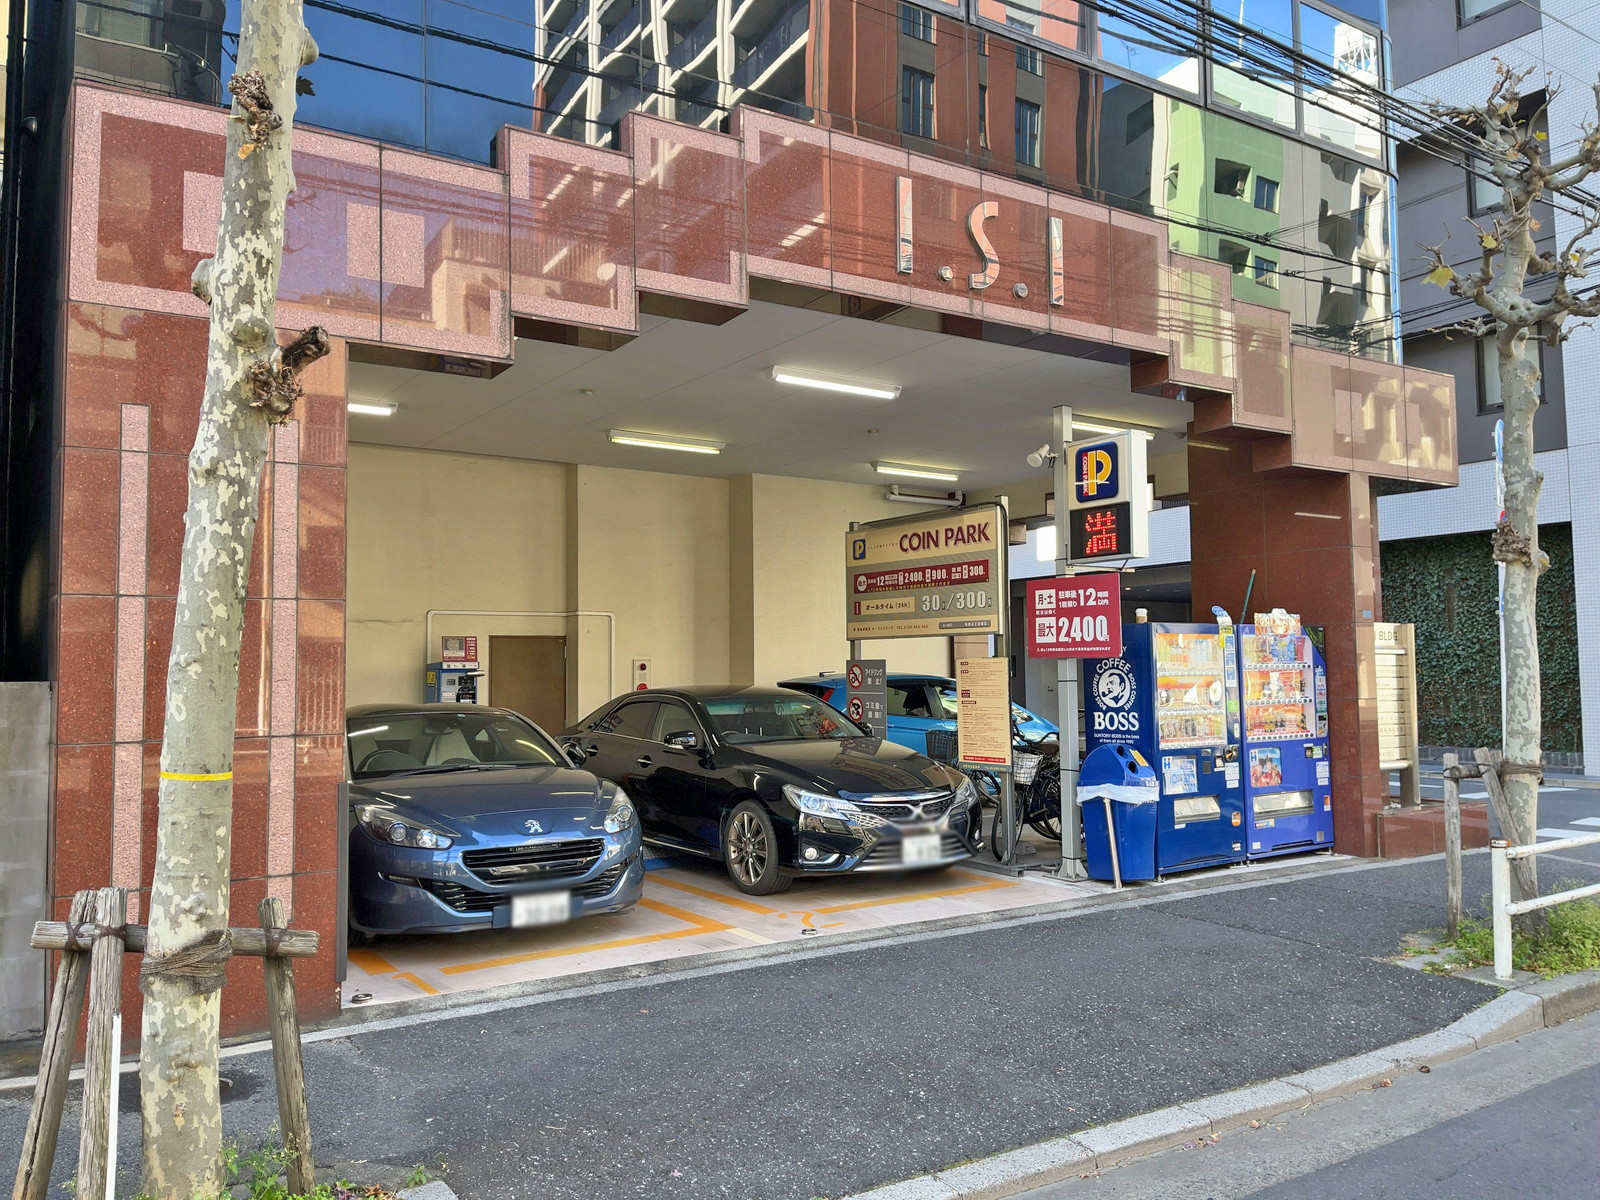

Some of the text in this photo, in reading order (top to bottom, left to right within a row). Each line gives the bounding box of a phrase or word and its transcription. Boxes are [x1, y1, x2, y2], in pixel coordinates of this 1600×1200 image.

[900, 530, 939, 553] COIN
[944, 522, 990, 547] PARK
[1085, 511, 1117, 553] 満
[876, 575, 885, 586] 12
[1059, 600, 1077, 608] 1回限り
[1078, 588, 1097, 606] 12
[1038, 623, 1054, 637] 最大
[865, 668, 883, 676] アイドリング
[1096, 658, 1131, 673] COFFEE
[1092, 674, 1100, 696] COFFEE
[1124, 673, 1137, 710] BOSS COFFEE
[1093, 711, 1139, 731] BOSS
